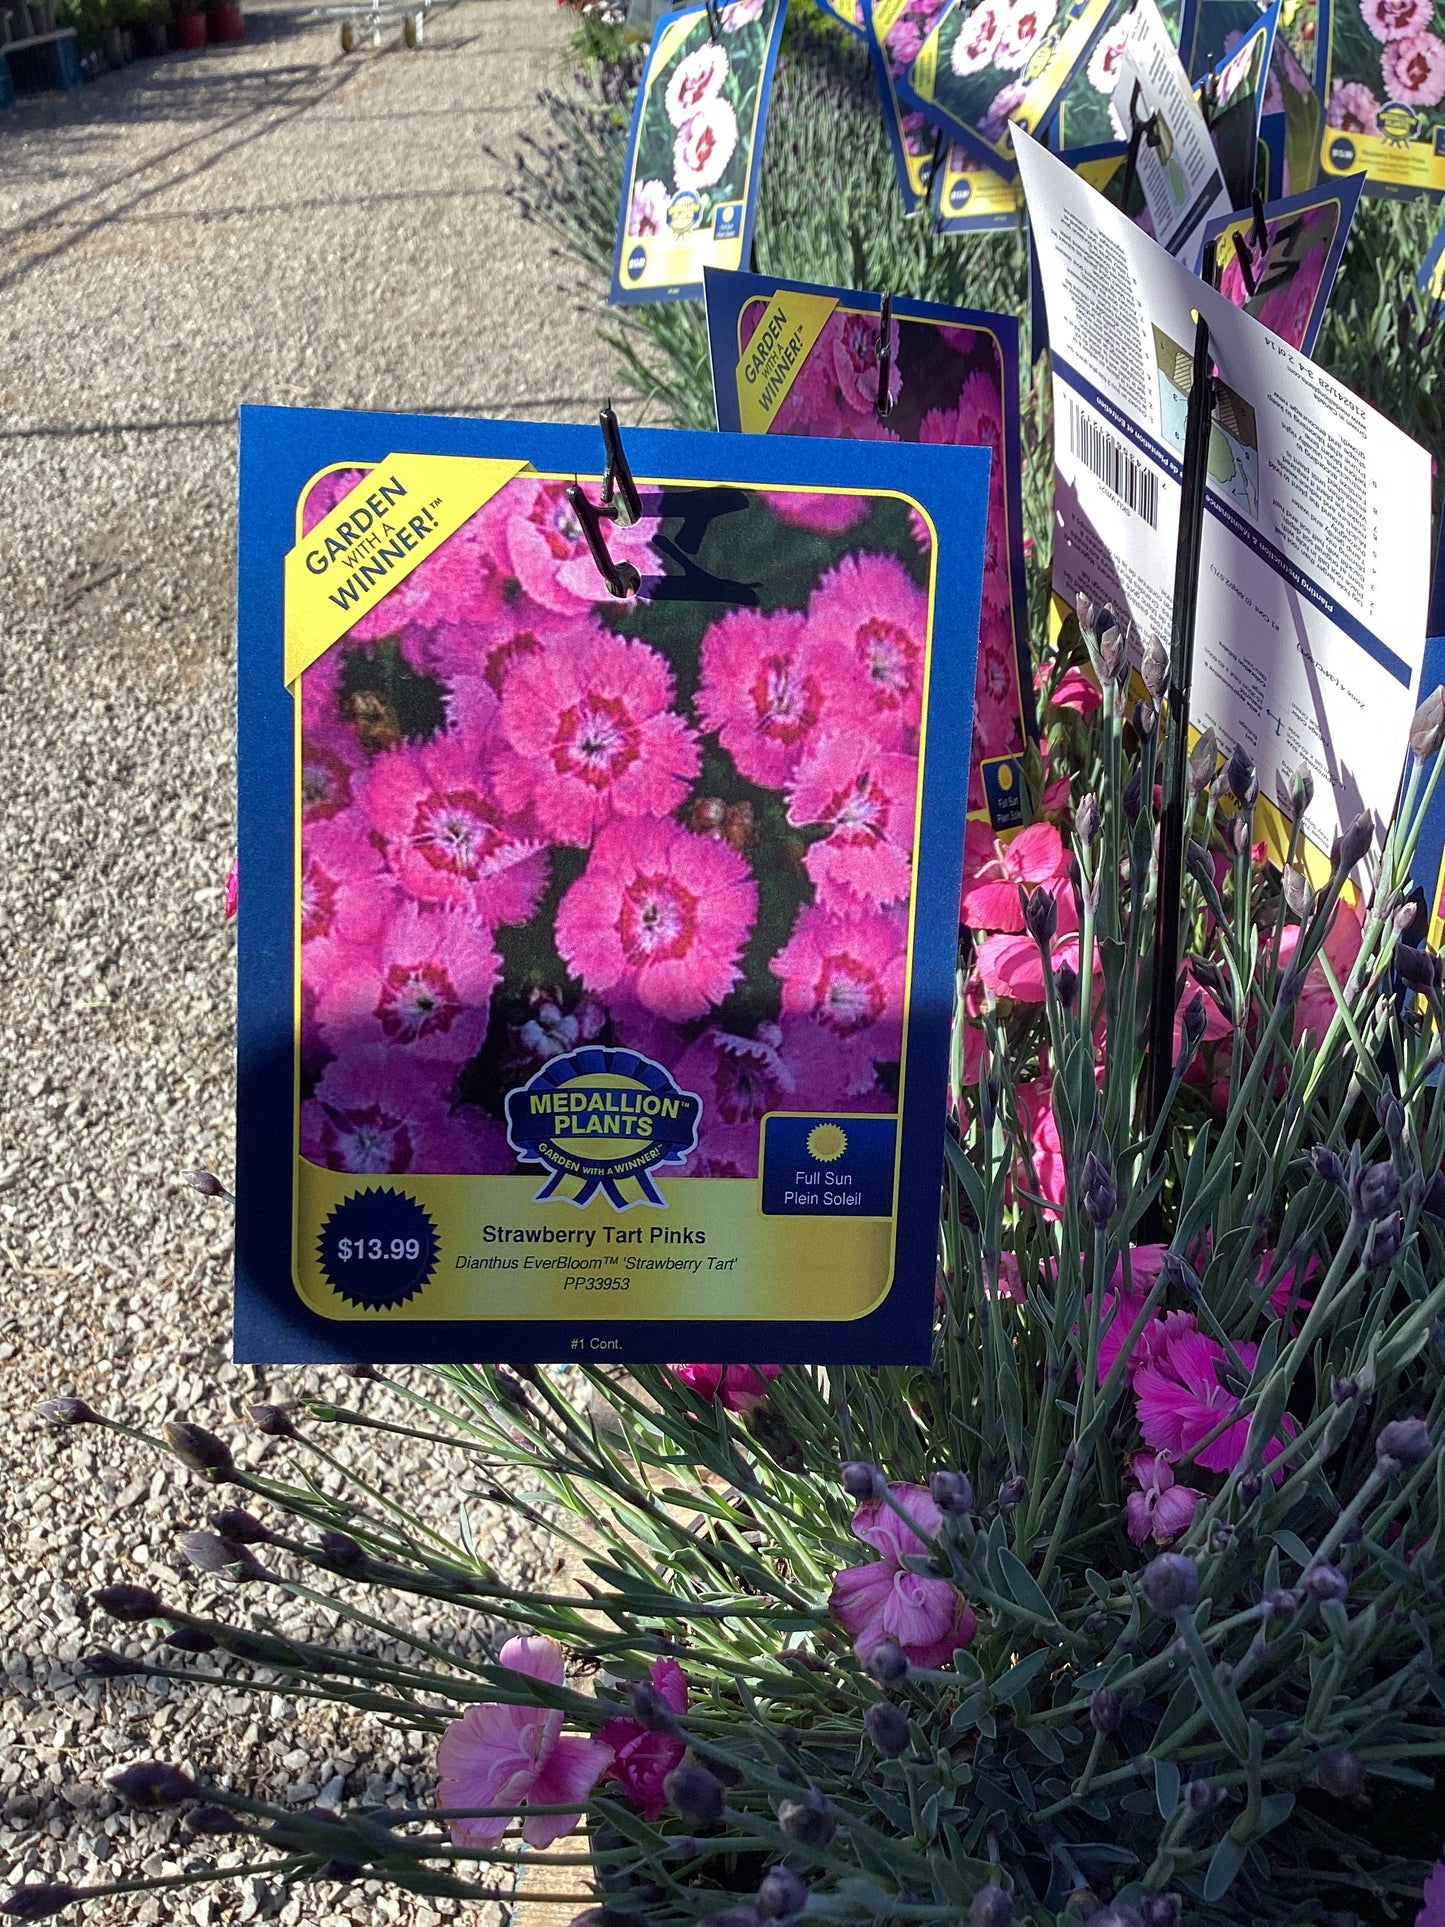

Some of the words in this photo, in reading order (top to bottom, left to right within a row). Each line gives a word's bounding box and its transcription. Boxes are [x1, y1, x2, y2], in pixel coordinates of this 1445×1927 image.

[745, 307, 787, 384] GARDEN
[1264, 336, 1274, 349] 14
[1278, 346, 1285, 359] of
[762, 352, 778, 379] WITH
[777, 344, 784, 354] A
[1288, 354, 1293, 363] 2
[1298, 360, 1313, 379] 3-4
[1318, 377, 1365, 419] 216241/28
[1096, 394, 1125, 428] Entretien
[1080, 406, 1110, 441] 21212
[1126, 421, 1133, 436] et
[1134, 428, 1168, 468] Plantation
[1170, 461, 1178, 477] de
[1116, 498, 1130, 518] SKU
[1205, 492, 1249, 539] Maintenance
[305, 475, 407, 575] GARDEN
[341, 533, 382, 569] WITH
[382, 523, 395, 536] A
[1252, 534, 1257, 545] &
[1259, 540, 1299, 583] Instruction
[1301, 576, 1333, 613] Planting
[1347, 688, 1364, 710] Zone
[554, 1114, 653, 1136] PLANTS
[539, 1142, 580, 1172] GARDEN
[582, 1167, 605, 1175] WITH
[796, 1172, 820, 1185] Full
[825, 1172, 852, 1185] Sun
[784, 1191, 818, 1204] Plein
[823, 1191, 861, 1205] Soleil
[482, 1225, 596, 1247] Strawberry
[602, 1227, 642, 1244] Tart
[649, 1227, 706, 1244] Pinks
[337, 1238, 420, 1262] $13.99
[455, 1255, 519, 1271] Dianthus
[623, 1256, 702, 1273] 'Strawberry
[706, 1256, 739, 1271] Tart'
[563, 1277, 630, 1291] PP33953
[570, 1338, 585, 1350] #1
[590, 1338, 623, 1350] Cont.
